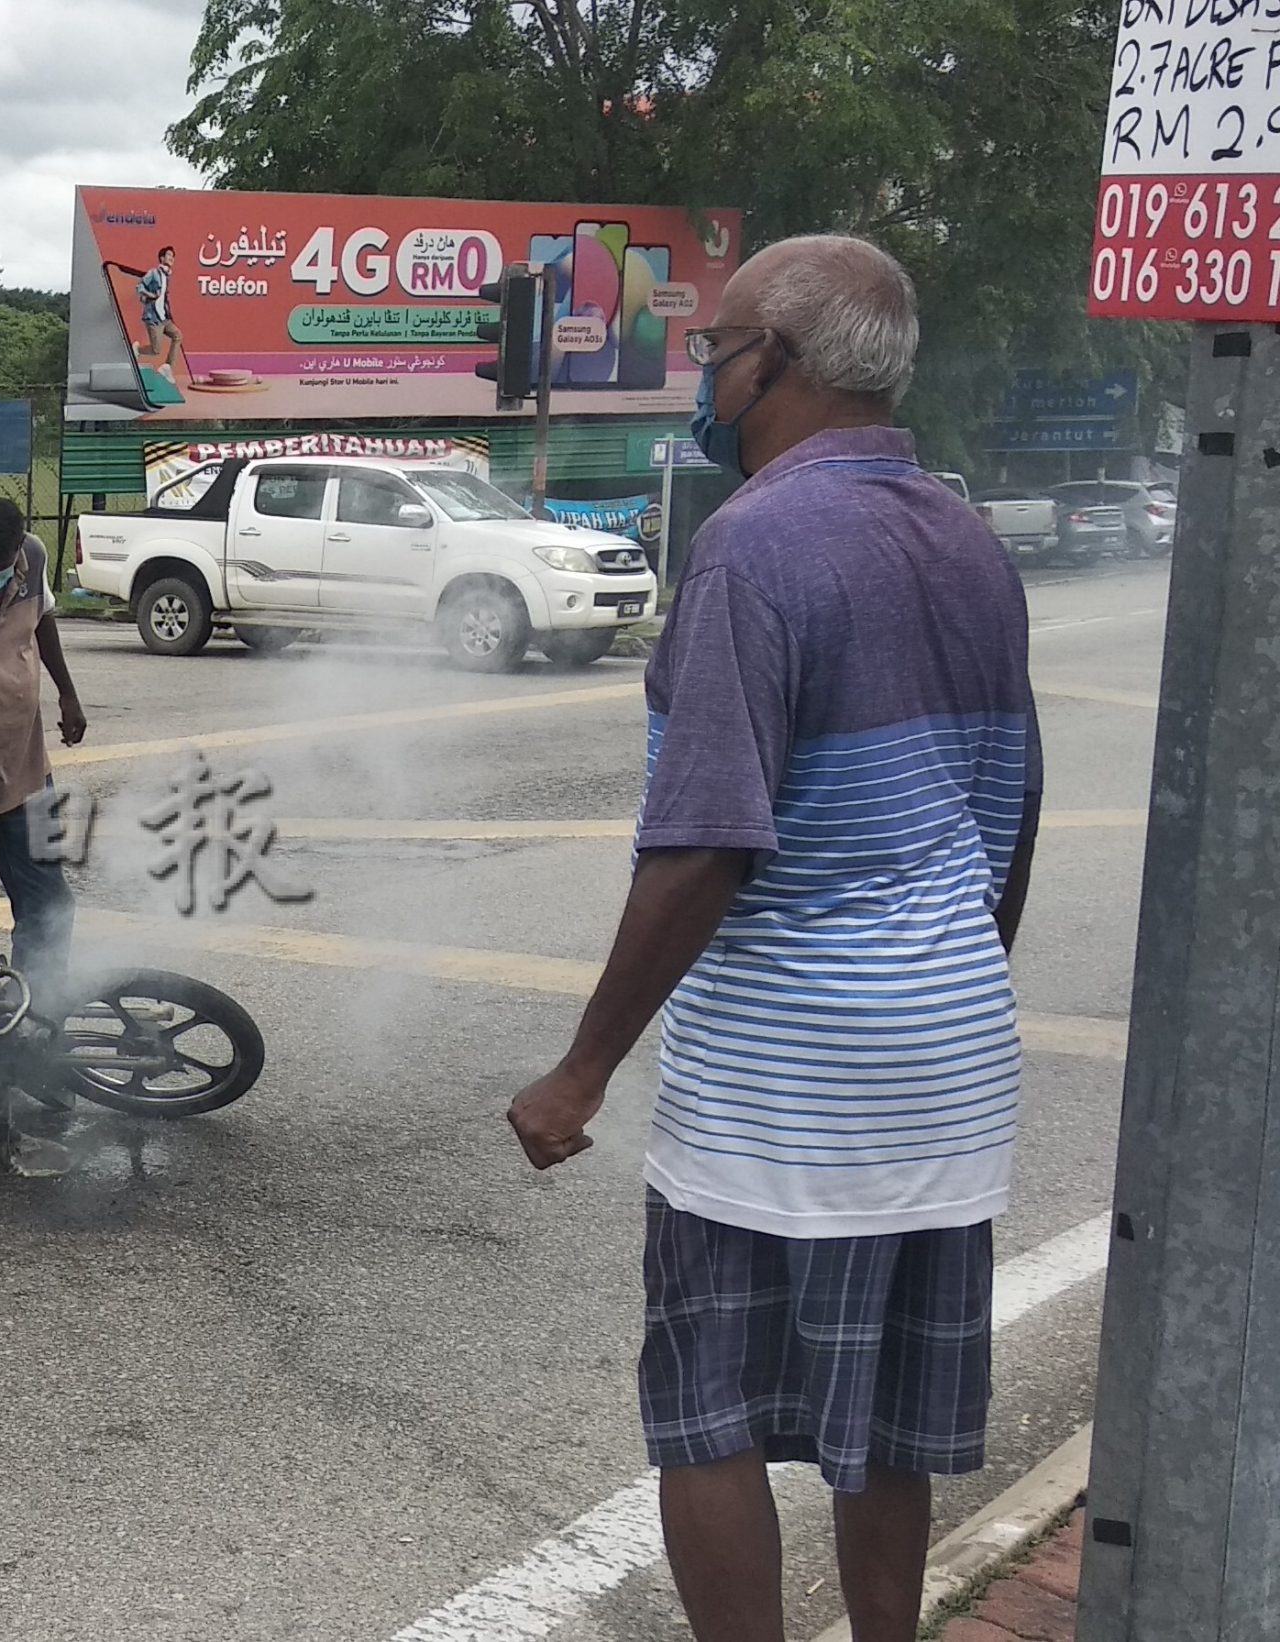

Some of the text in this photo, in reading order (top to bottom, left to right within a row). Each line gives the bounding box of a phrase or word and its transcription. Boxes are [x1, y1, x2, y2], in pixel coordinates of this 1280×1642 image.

[1112, 104, 1190, 163] RM
[1100, 183, 1168, 238] 019
[1184, 183, 1258, 239] 613
[198, 225, 286, 266] تيليفون
[291, 227, 391, 295] 4G
[1093, 247, 1159, 302] 016
[1175, 249, 1252, 305] 330
[198, 276, 268, 295] Telefon
[653, 289, 685, 298] Samsung
[653, 299, 676, 309] Galaxy
[330, 330, 350, 338] Tanpa
[411, 330, 429, 338] Tanpa
[431, 330, 456, 338] Bayaran
[558, 325, 592, 335] Samsung
[558, 335, 582, 344] Galaxy
[344, 358, 350, 367] U
[352, 358, 383, 367] Mobile
[299, 378, 329, 387] Kunjungi
[1010, 396, 1097, 408] Tmerloh
[197, 433, 447, 461] PEMBERITAHUAN
